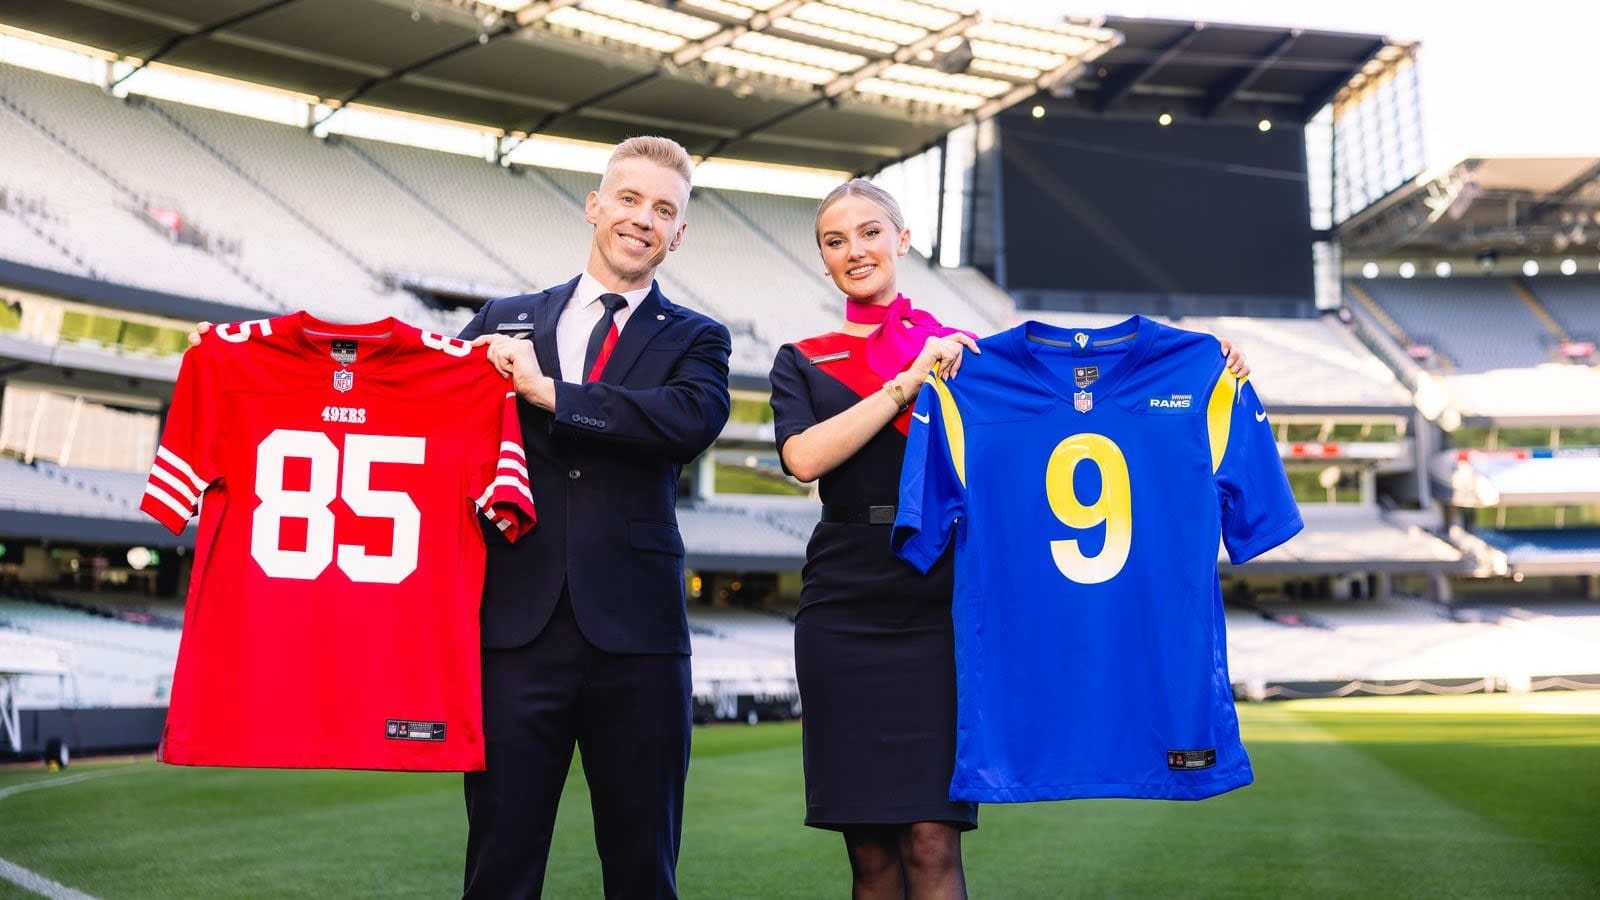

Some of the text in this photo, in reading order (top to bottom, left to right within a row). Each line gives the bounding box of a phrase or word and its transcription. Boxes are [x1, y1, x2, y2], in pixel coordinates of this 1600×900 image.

[321, 406, 366, 423] 49ERS
[1150, 399, 1191, 408] RAMS
[251, 428, 427, 585] 85
[1045, 432, 1132, 584] 9
